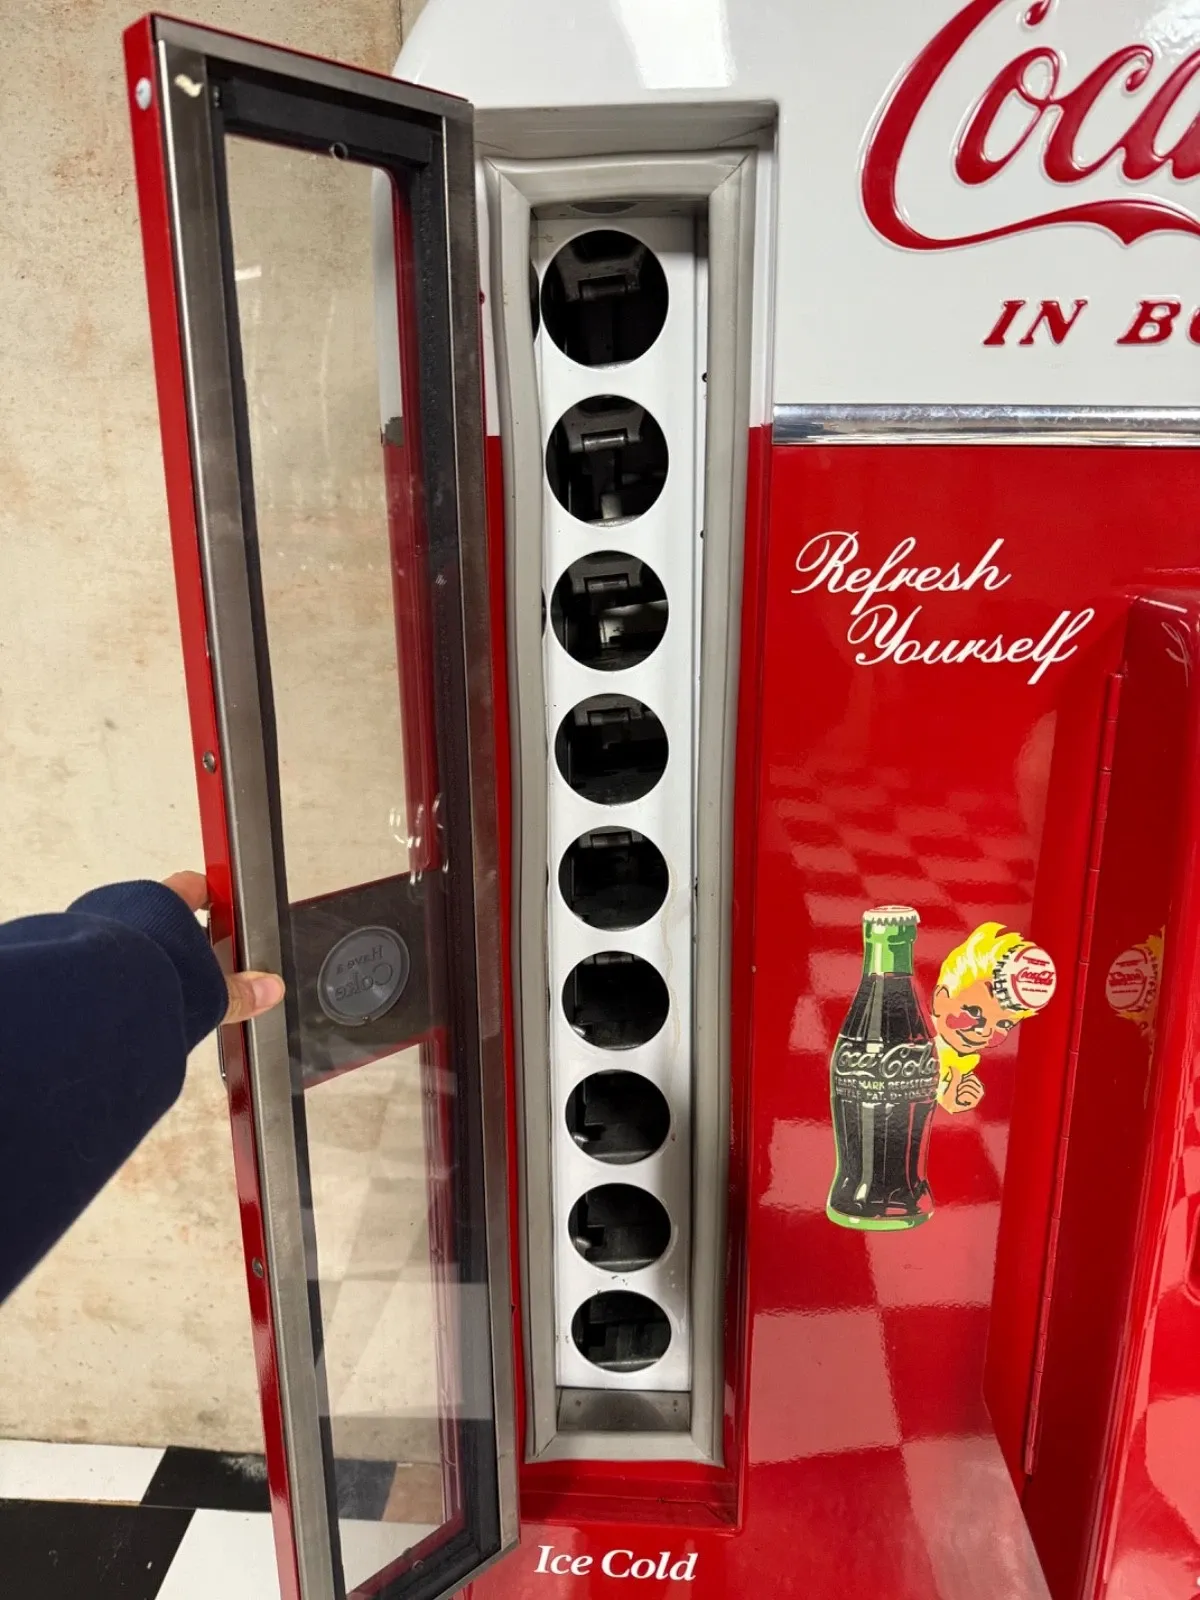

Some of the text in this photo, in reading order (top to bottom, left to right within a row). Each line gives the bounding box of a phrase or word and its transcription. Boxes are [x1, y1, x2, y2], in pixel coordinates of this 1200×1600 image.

[983, 299, 1088, 346] IN
[791, 531, 1012, 615] Refresh
[847, 604, 1095, 685] Yourself
[534, 1545, 698, 1581] Ice Cold
